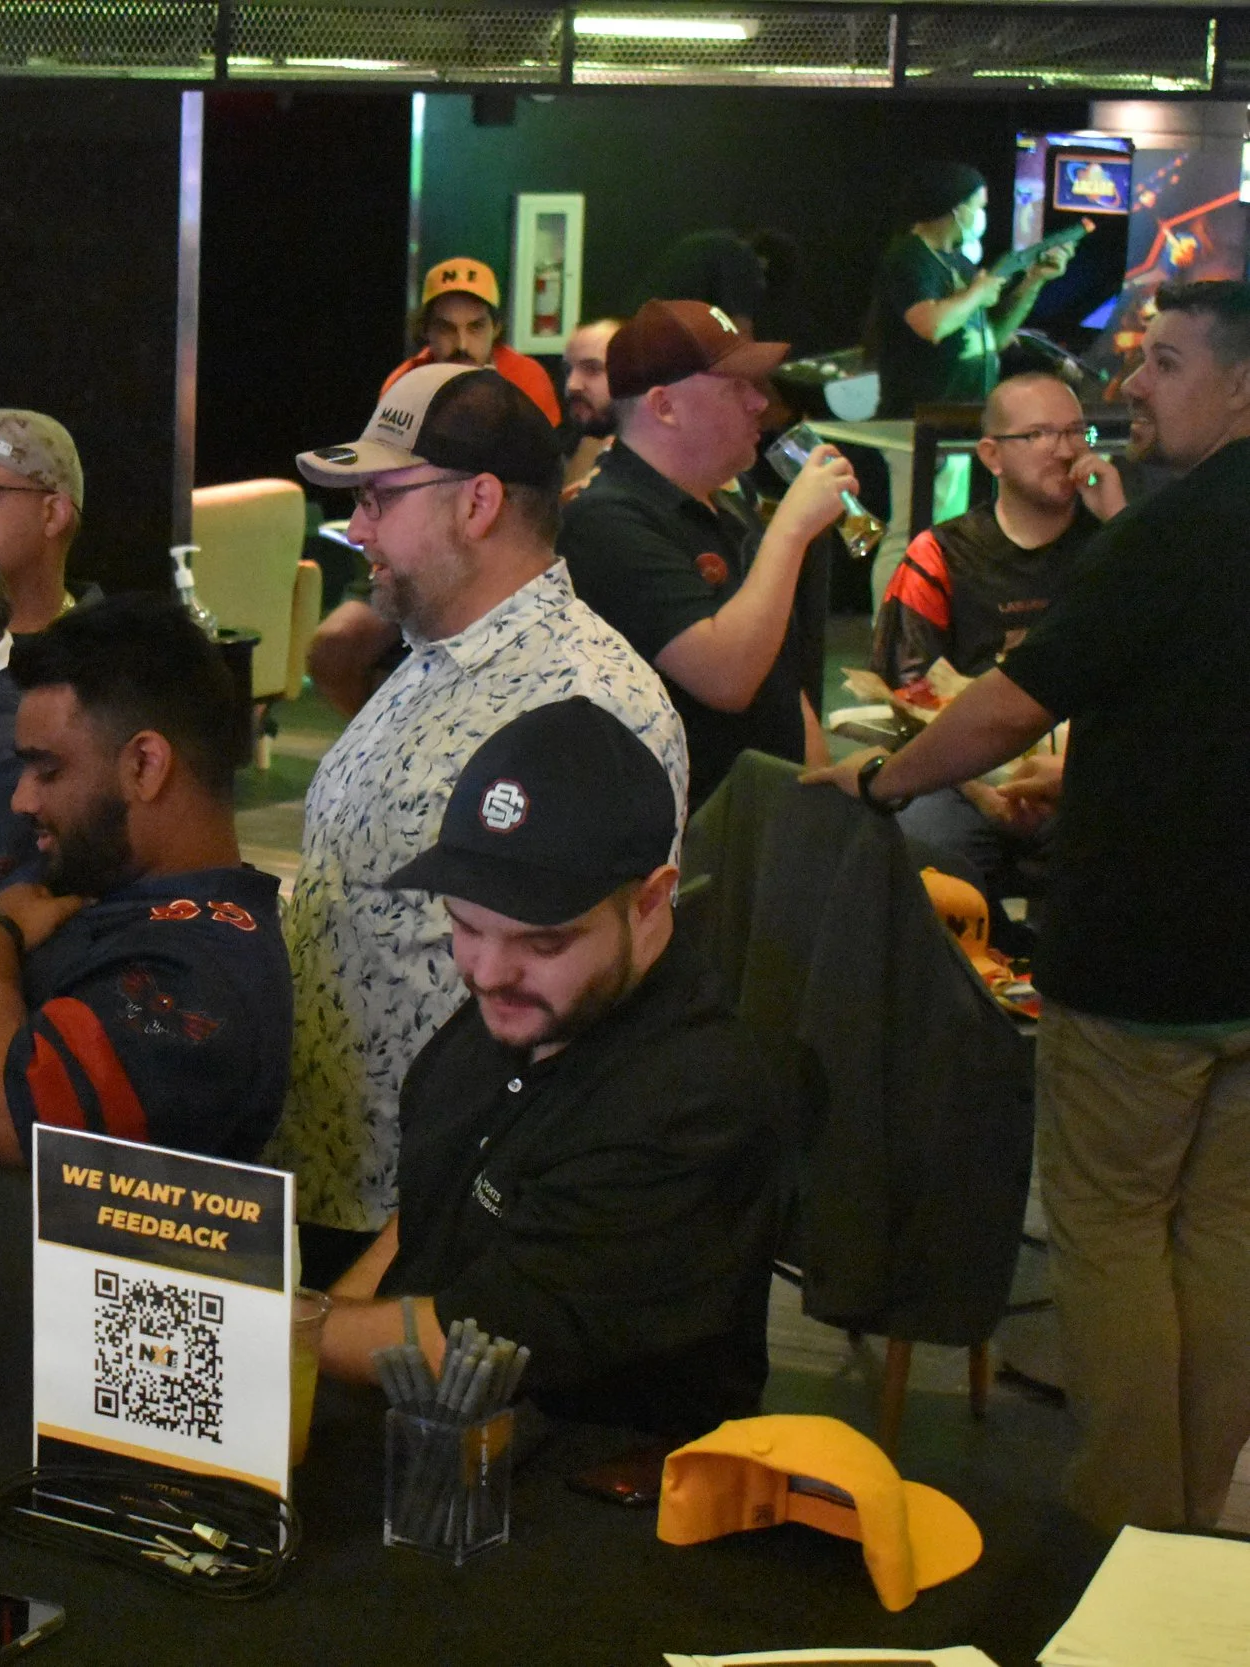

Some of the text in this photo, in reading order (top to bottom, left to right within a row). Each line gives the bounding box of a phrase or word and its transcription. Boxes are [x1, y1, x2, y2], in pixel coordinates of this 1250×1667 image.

[379, 407, 414, 430] MAUI
[61, 1163, 261, 1223] WE WANT YOUR
[96, 1205, 230, 1250] FEEDBACK
[139, 1342, 178, 1367] NXT
